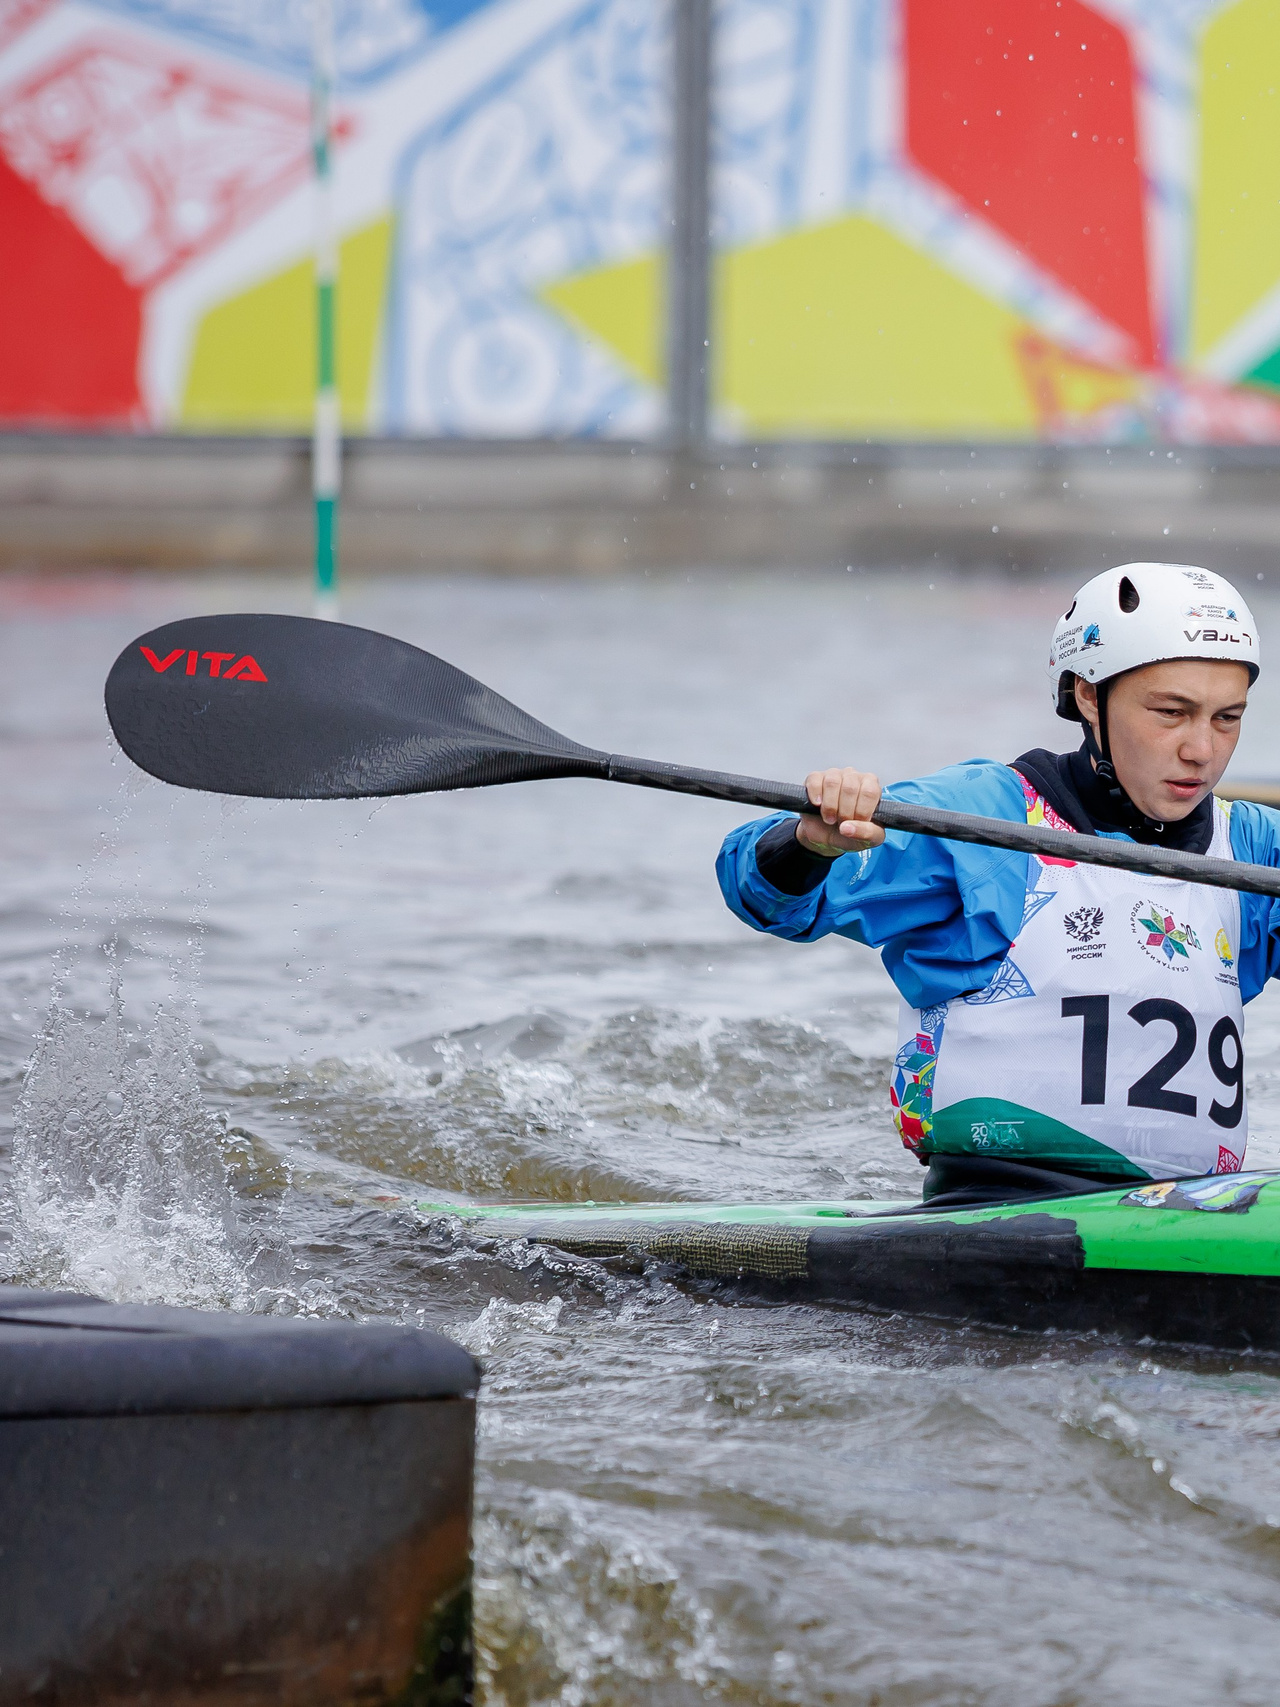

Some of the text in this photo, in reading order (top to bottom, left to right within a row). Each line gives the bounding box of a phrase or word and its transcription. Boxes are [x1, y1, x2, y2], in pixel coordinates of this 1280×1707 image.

[139, 646, 269, 683] VITA
[1129, 900, 1145, 934] НАРОДОВ
[1066, 943, 1107, 954] МИНСПОРТ
[1071, 952, 1103, 961] РОССИИ
[1061, 994, 1244, 1129] 129
[970, 1125, 989, 1139] 20
[972, 1136, 991, 1148] 26
